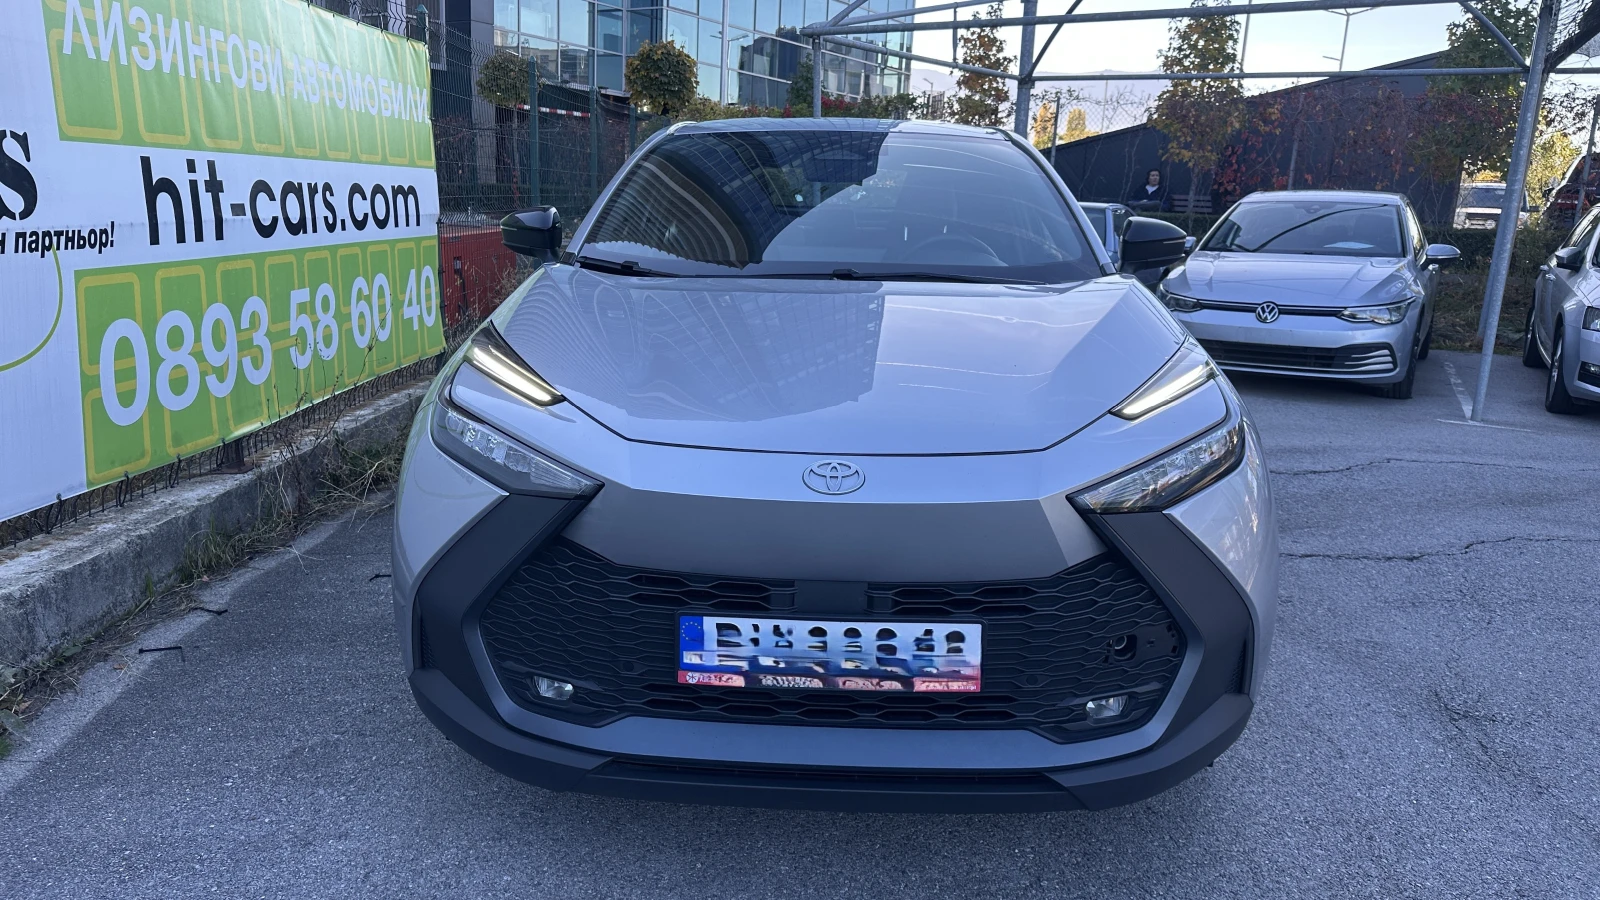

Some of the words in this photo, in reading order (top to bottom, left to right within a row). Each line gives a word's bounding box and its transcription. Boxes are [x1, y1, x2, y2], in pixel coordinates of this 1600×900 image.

[63, 0, 285, 96] ЛИЗИНГОВИ
[293, 53, 428, 123] АВТОМОБИЛИ
[14, 221, 115, 258] партньор!
[140, 155, 421, 245] hit-cars.com
[100, 295, 272, 427] 0893
[289, 283, 339, 370] 58
[350, 272, 392, 349] 60
[403, 265, 437, 331] 40
